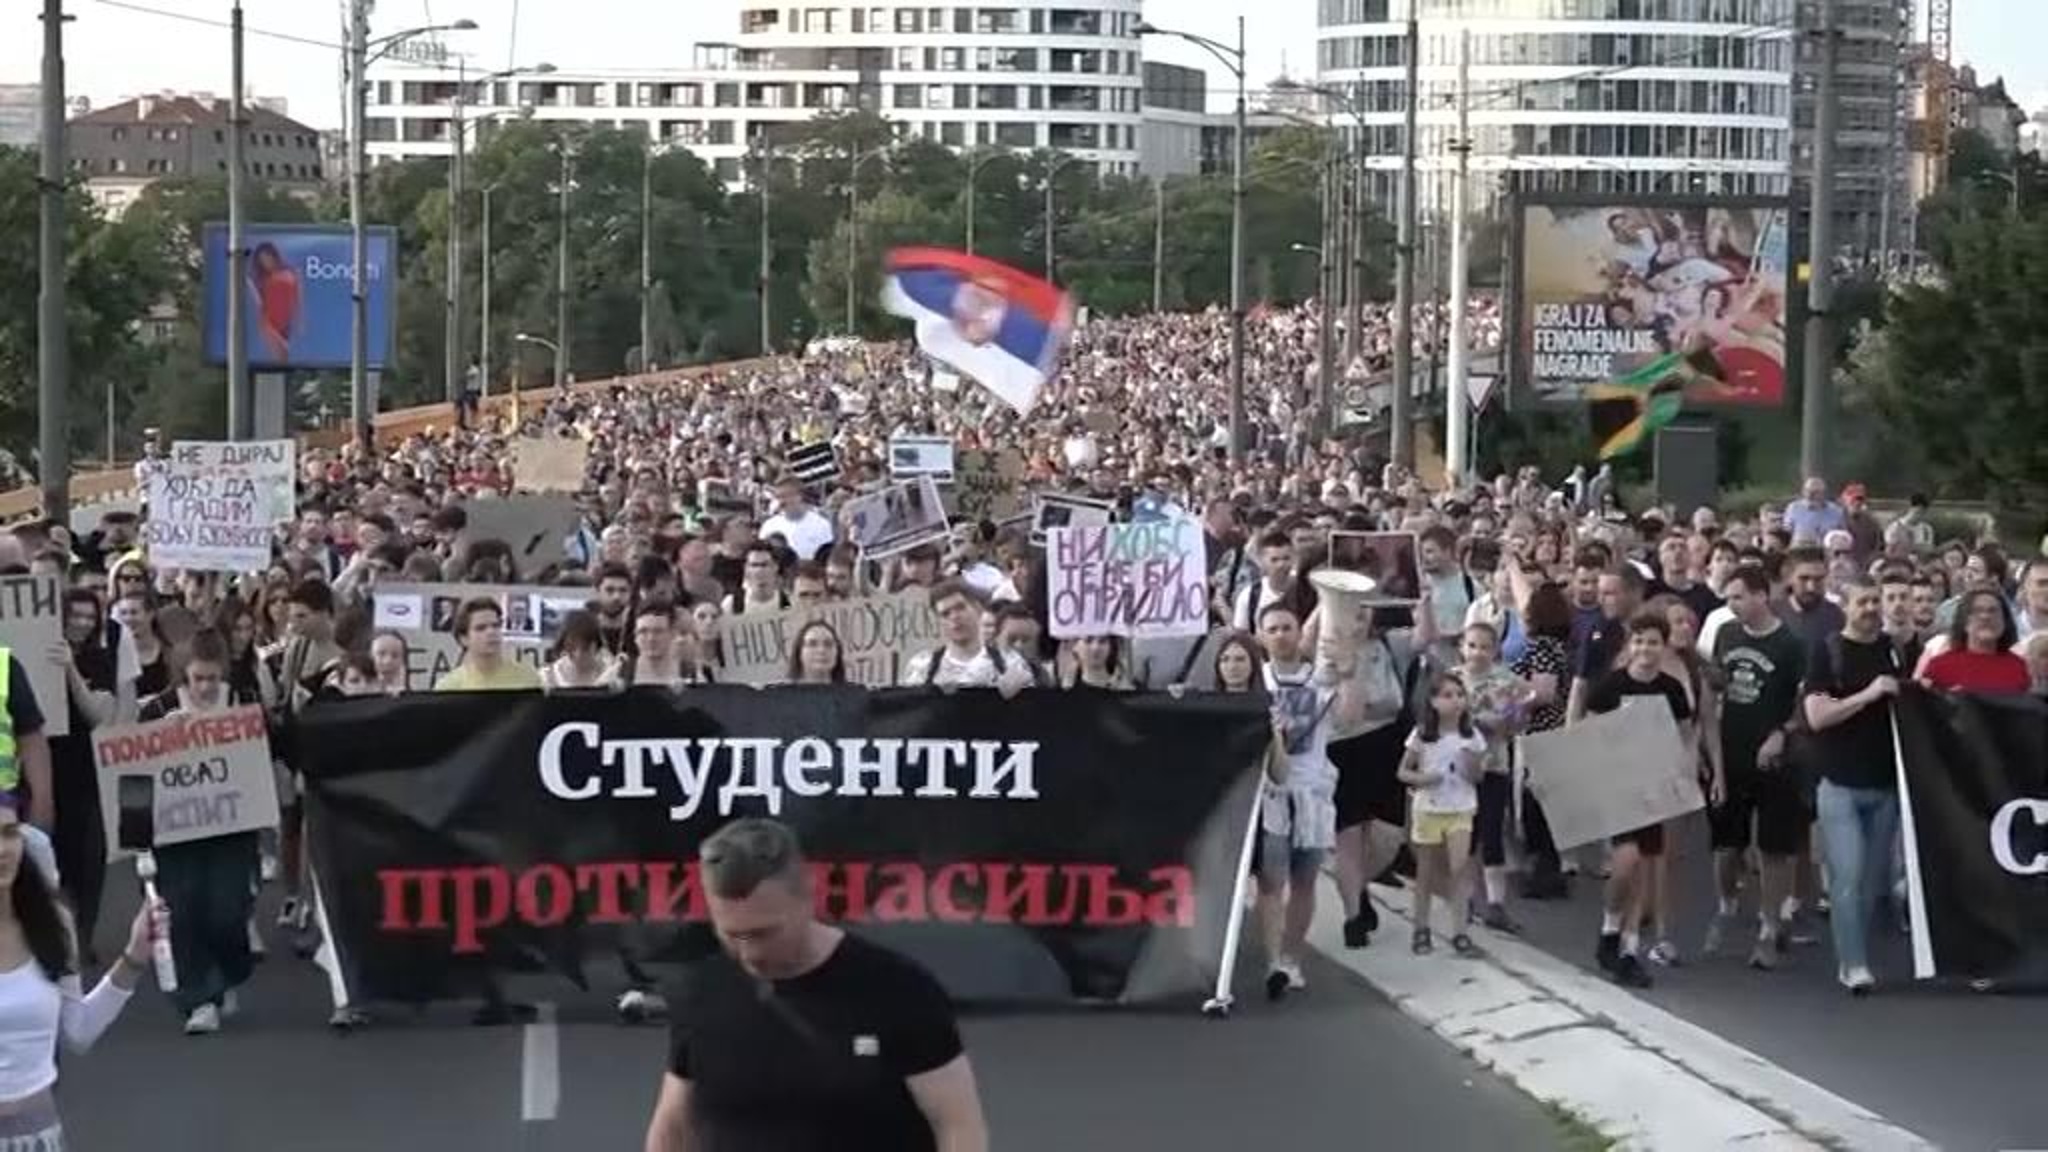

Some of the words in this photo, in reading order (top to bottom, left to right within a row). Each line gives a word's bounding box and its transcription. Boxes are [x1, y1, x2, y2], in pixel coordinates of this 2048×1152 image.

[1533, 304, 1581, 327] IGRAJ
[1585, 304, 1606, 327] ZA
[1533, 330, 1656, 353] FENOMENALNE
[1533, 354, 1613, 377] NAGRADE
[221, 477, 257, 501] ДА
[1057, 526, 1107, 569] НИ
[1058, 562, 1100, 597] ТЕ
[1144, 556, 1187, 588] БИ
[161, 757, 229, 788] ОВАЈ
[538, 722, 1040, 820] Студенти
[1989, 797, 2048, 875] С
[378, 857, 706, 953] проти
[812, 858, 1196, 930] насиља
